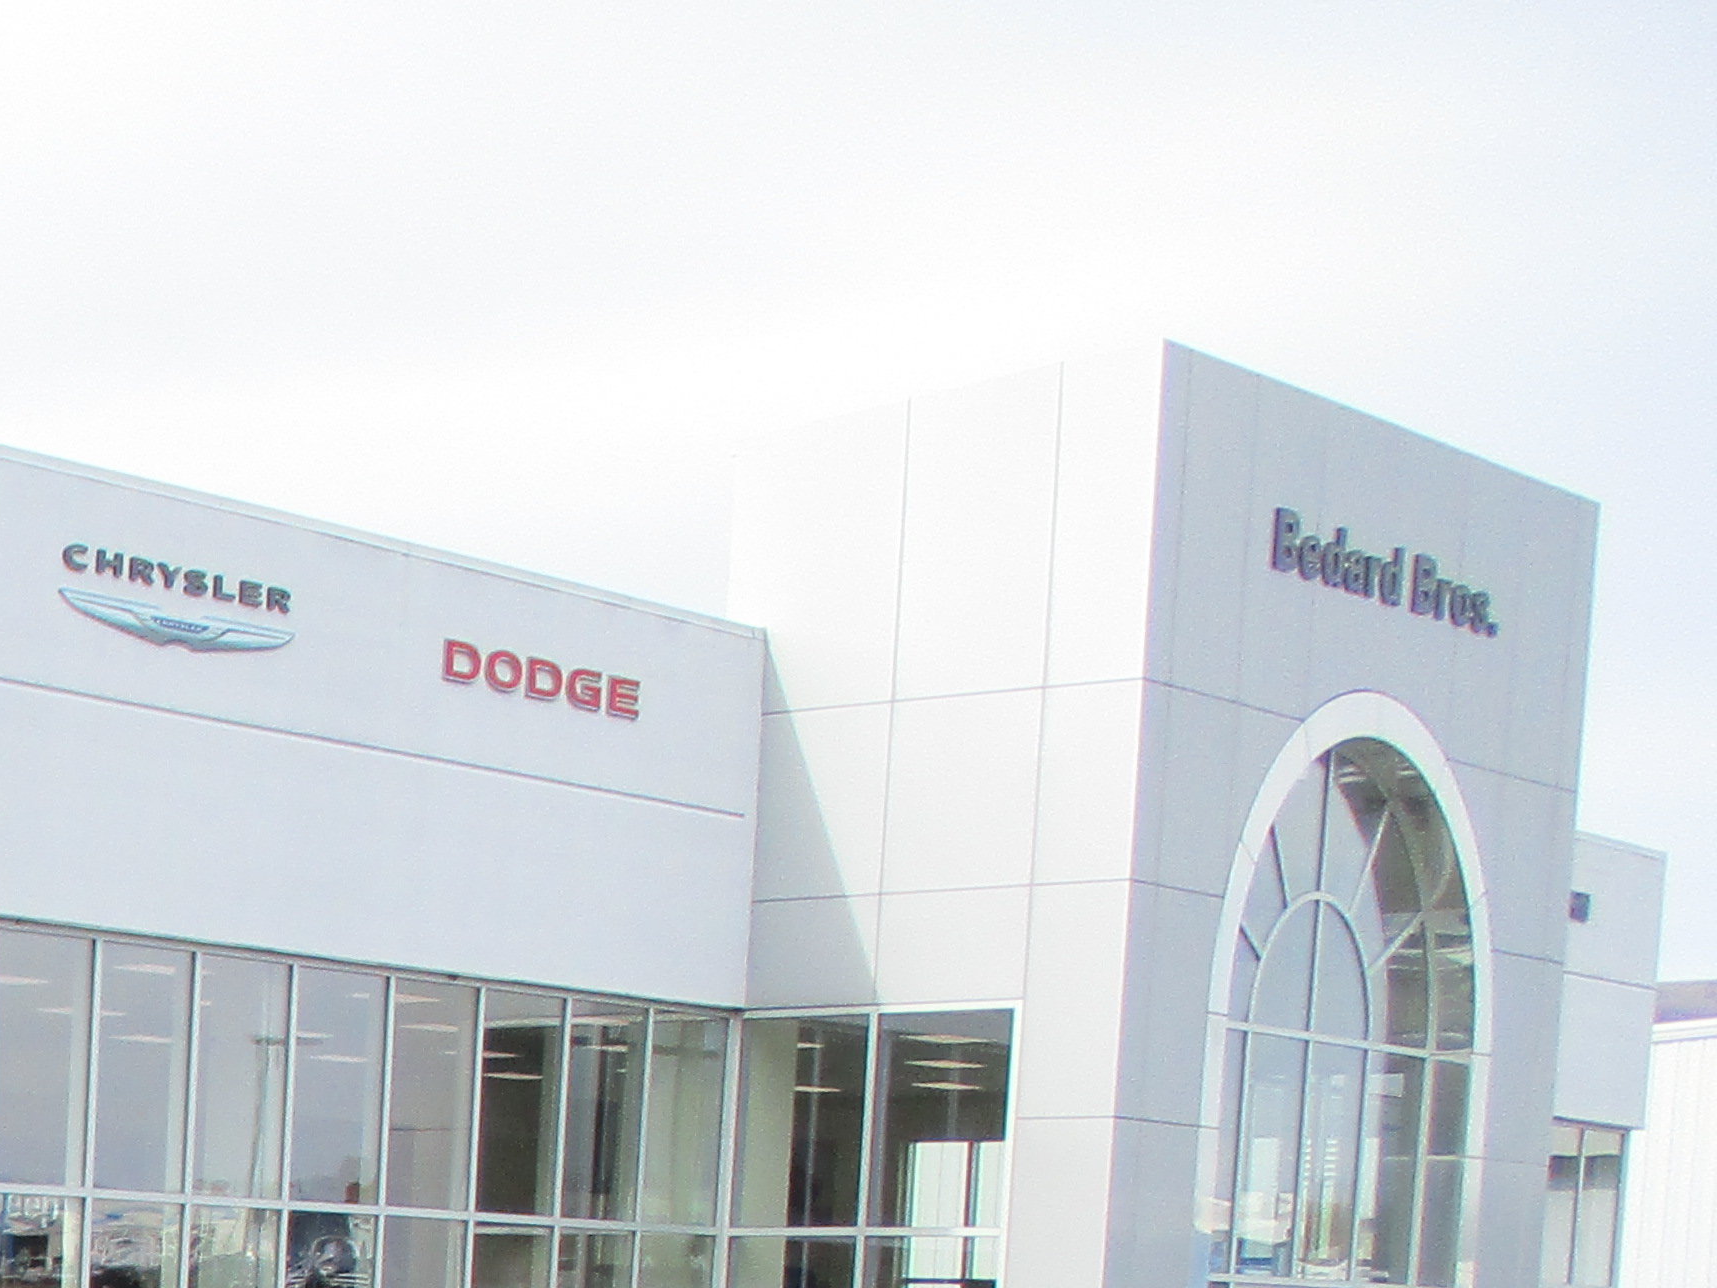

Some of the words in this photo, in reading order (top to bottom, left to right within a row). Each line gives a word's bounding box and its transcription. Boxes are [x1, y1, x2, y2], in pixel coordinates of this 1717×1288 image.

[61, 544, 292, 614] CHRYSLER
[1271, 507, 1406, 606] Bedard
[1409, 553, 1499, 638] Bros.
[441, 639, 641, 720] DODGE
